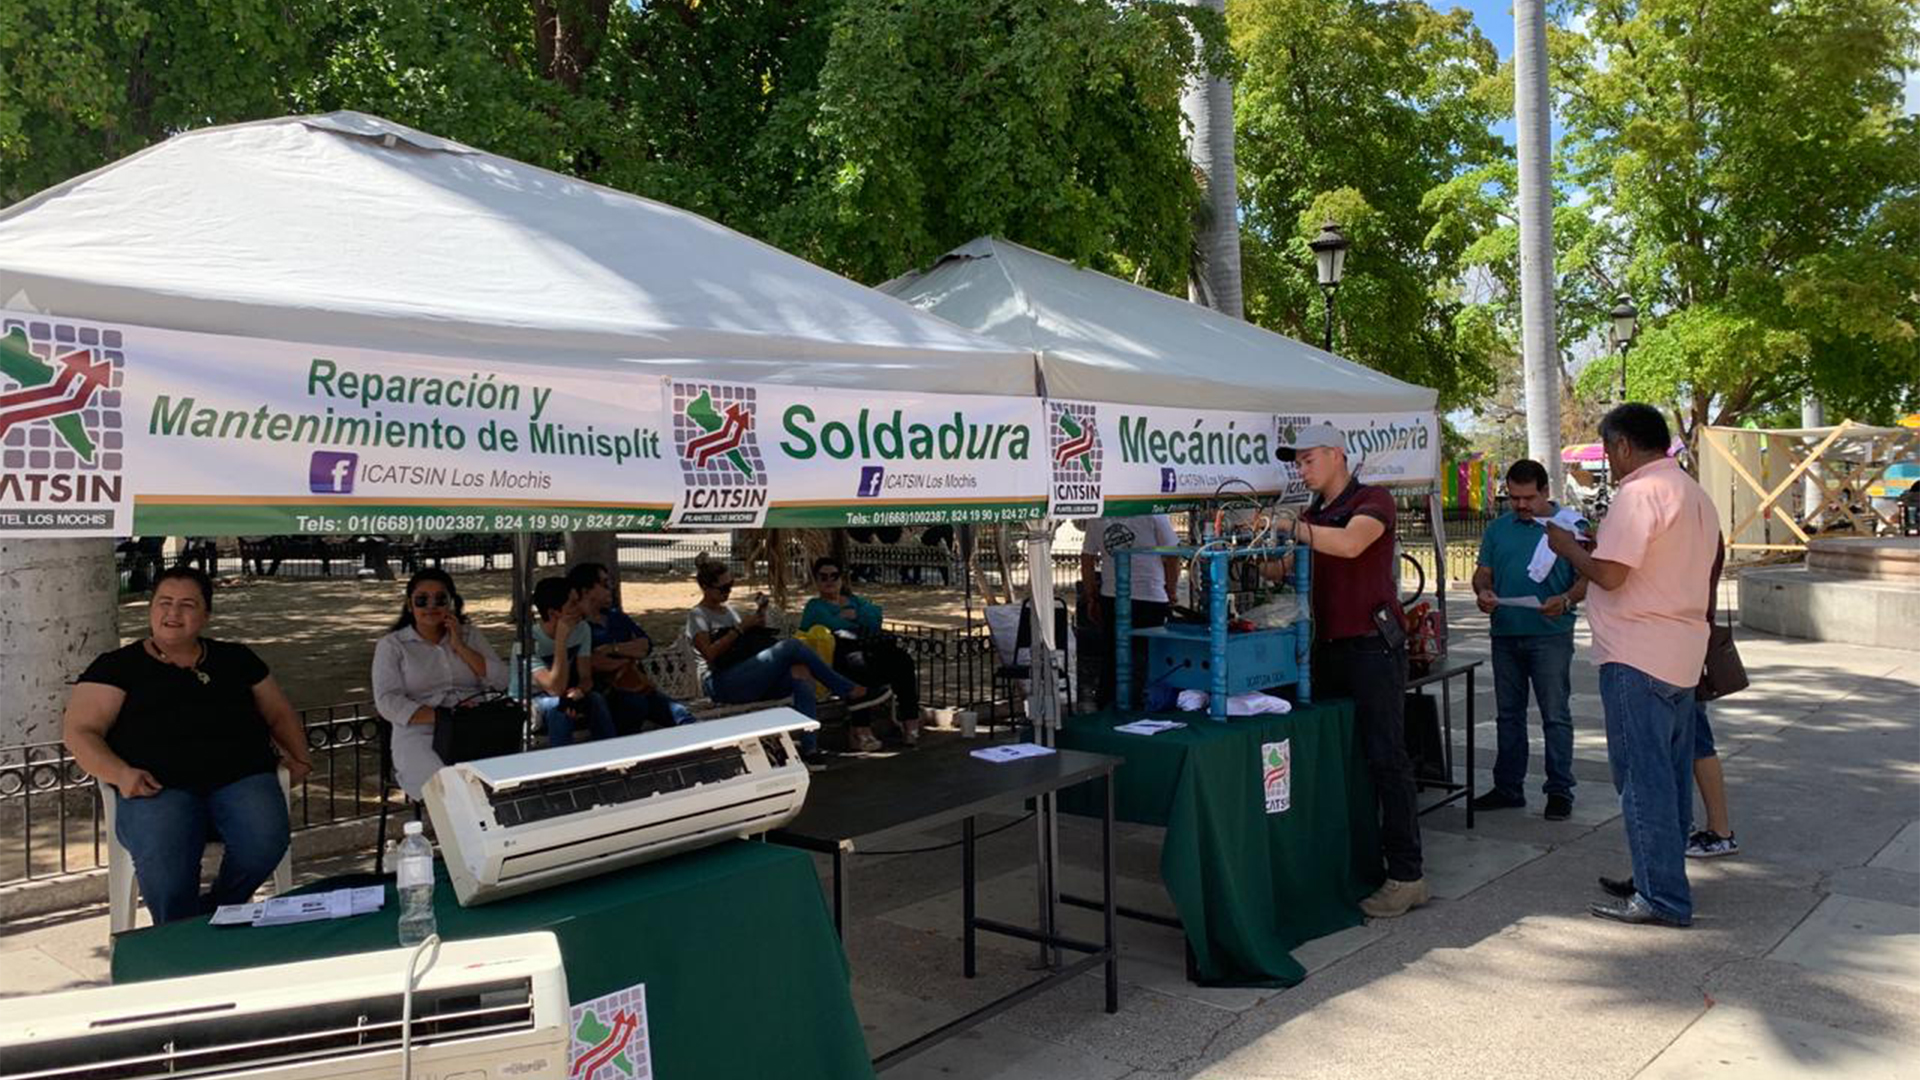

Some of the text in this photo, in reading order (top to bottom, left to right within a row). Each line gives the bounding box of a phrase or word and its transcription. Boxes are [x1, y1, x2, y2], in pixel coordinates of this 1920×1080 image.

[307, 358, 552, 420] Reparación y
[149, 395, 662, 465] Mantenimiento de Minisplit
[779, 404, 1030, 461] Soldadura
[1118, 414, 1269, 465] Mecánica
[360, 464, 552, 489] ICATSIN Los Mochis
[884, 474, 977, 489] ICATSIN Los Mochis
[683, 488, 768, 509] ICATSIN
[1054, 484, 1100, 500] ICATSIN
[28, 514, 54, 525] LOS
[57, 514, 106, 525] MOCHIS
[296, 513, 655, 533] Tels: 01(668)1002387, 824 19 90 y 824 27 42
[846, 513, 870, 525] Tels:
[951, 510, 967, 522] 824
[970, 509, 980, 521] 19
[982, 509, 992, 521] 90
[1001, 508, 1016, 520] 824
[1018, 508, 1028, 520] 27
[1030, 508, 1040, 519] 42
